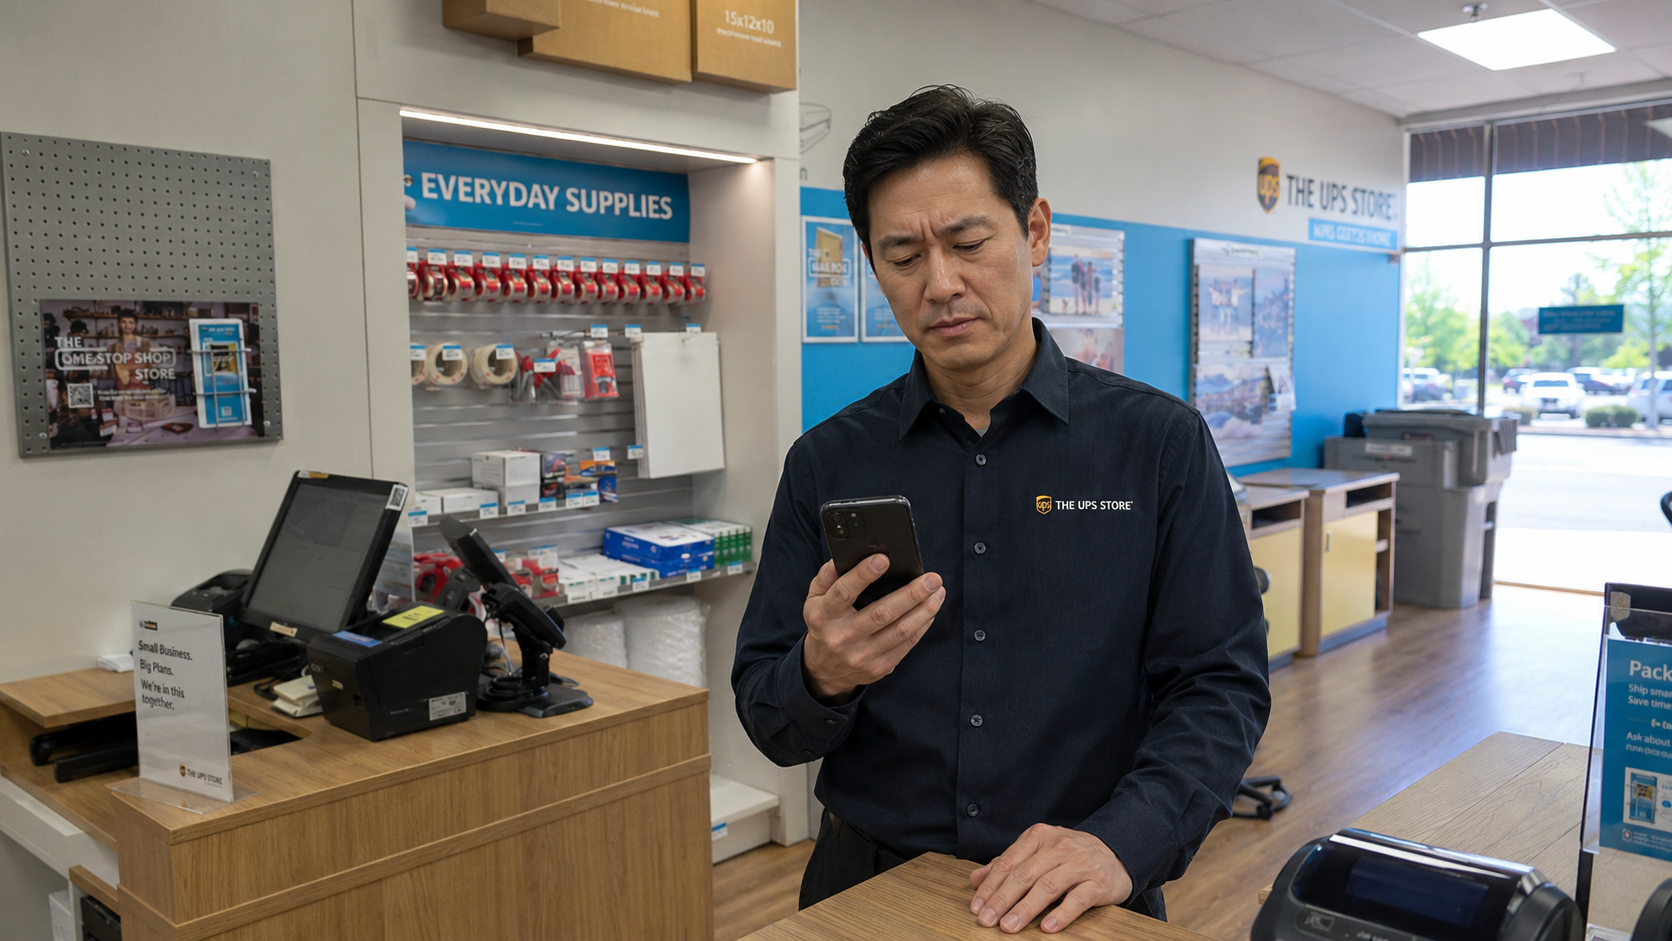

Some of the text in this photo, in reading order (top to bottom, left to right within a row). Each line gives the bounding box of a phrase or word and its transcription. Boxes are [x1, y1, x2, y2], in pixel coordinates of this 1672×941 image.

[724, 10, 775, 34] 15x12x10
[420, 172, 673, 220] EVERYDAY SUPPLIES
[1286, 173, 1315, 209] THE
[1320, 181, 1347, 213] UPS
[54, 336, 82, 348] THE
[134, 352, 171, 364] SHOP
[135, 368, 176, 380] STORE
[1055, 500, 1075, 510] THE
[1078, 500, 1098, 510] UPS
[138, 640, 193, 661] Small Business.
[140, 658, 174, 677] Big Plans.
[1629, 659, 1672, 682] Pack
[141, 678, 185, 699] We're in this
[1628, 683, 1649, 697] Ship
[142, 694, 175, 710] together.
[1627, 695, 1649, 707] Save
[1626, 731, 1671, 748] Ask about
[186, 768, 223, 785] THE UPS STORE
